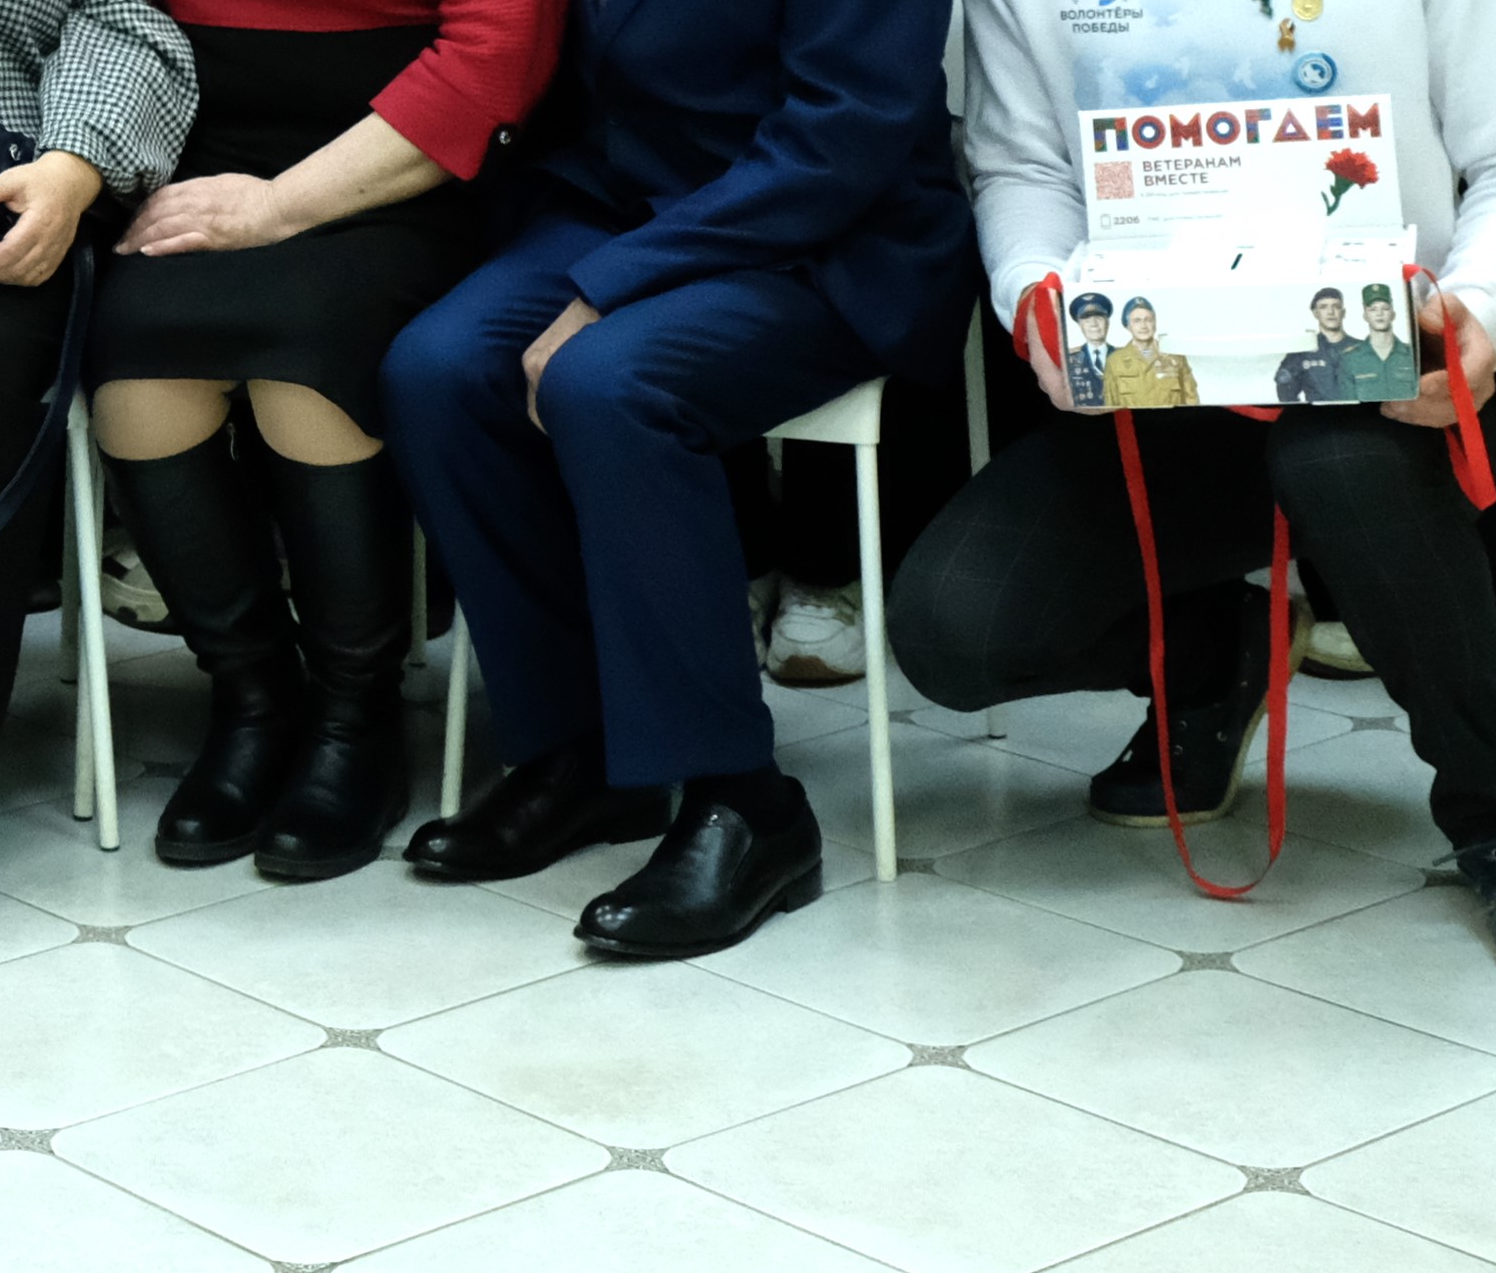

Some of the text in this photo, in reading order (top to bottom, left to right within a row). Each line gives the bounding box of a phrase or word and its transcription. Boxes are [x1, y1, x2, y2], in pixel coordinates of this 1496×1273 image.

[1060, 6, 1143, 21] ВОЛОНТЁРЫ
[1072, 22, 1129, 33] ПОБЕДЫ
[1092, 103, 1382, 152] ПОМОГАЕМ
[1142, 156, 1241, 172] ВЕТЕРАНАМ
[1144, 172, 1209, 187] ВМЕСТЕ
